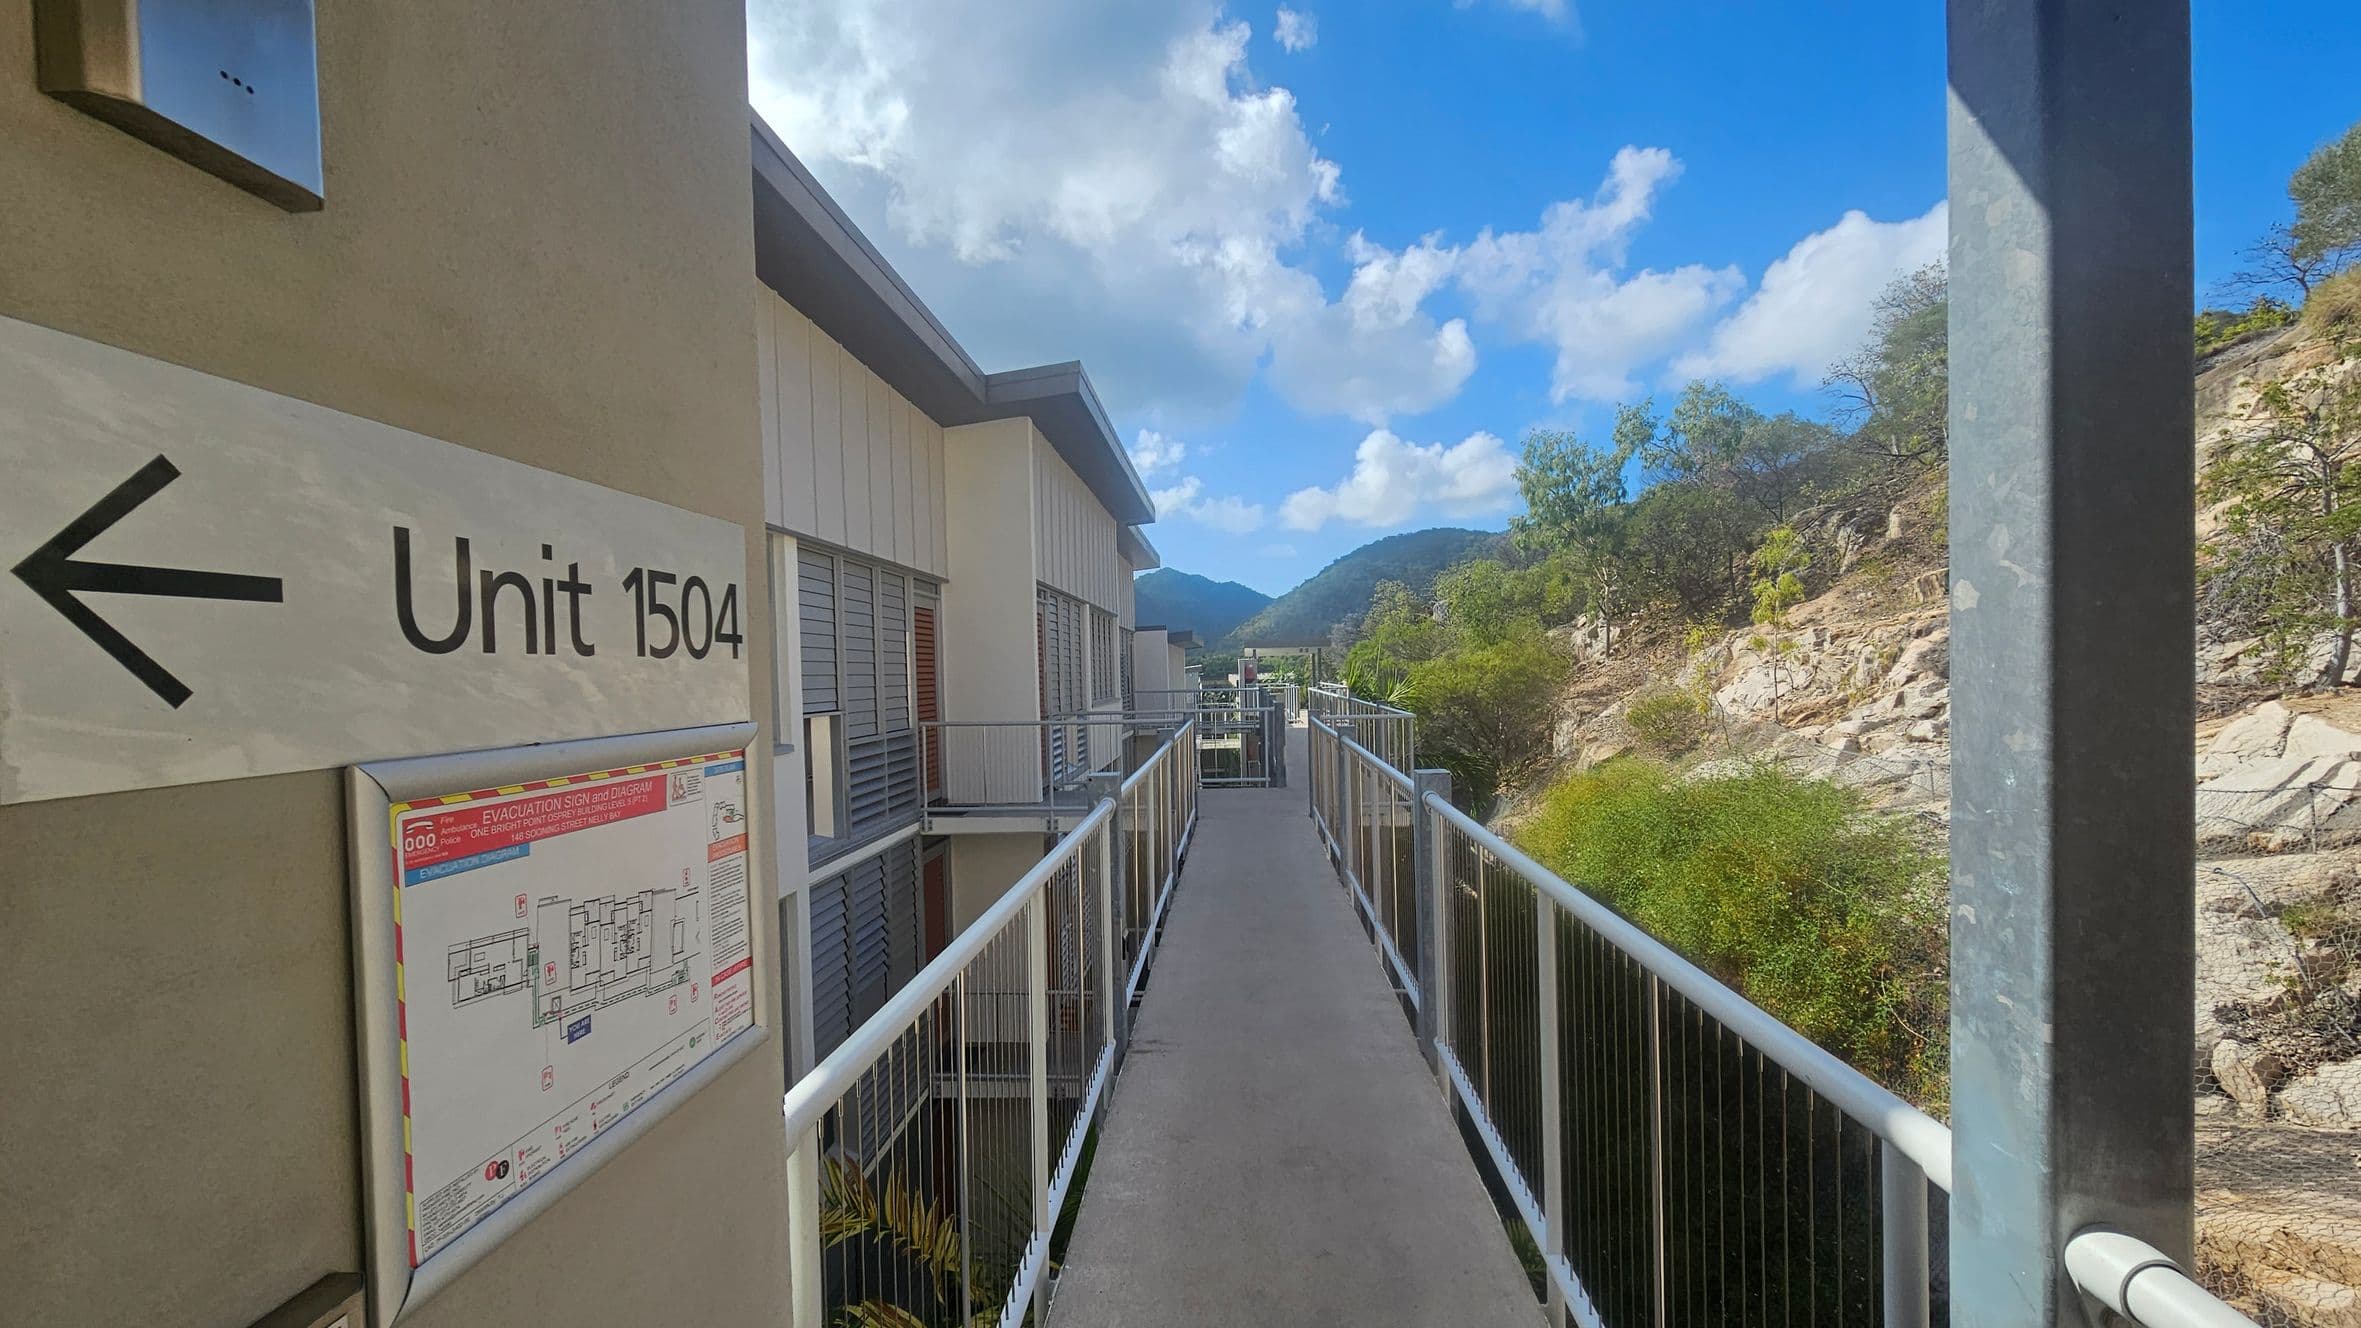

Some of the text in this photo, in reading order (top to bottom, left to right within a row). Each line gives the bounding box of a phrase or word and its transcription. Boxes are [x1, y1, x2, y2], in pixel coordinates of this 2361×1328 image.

[393, 525, 743, 660] Unit 1504
[482, 781, 653, 825] EVACUATION SIGN and DIAGRAM
[440, 816, 455, 824] Fire
[470, 826, 489, 839] ONE
[491, 820, 521, 834] BRIGHT
[523, 815, 546, 827] POINT
[547, 809, 576, 822] OSPREY
[577, 803, 607, 816] BUILDING
[608, 798, 626, 810] LEVEL
[561, 818, 587, 831] STREET
[588, 813, 608, 824] NELLY
[609, 810, 621, 819] BAY
[441, 823, 478, 836] Ambulance
[404, 833, 436, 851] 000
[441, 836, 461, 846] Police
